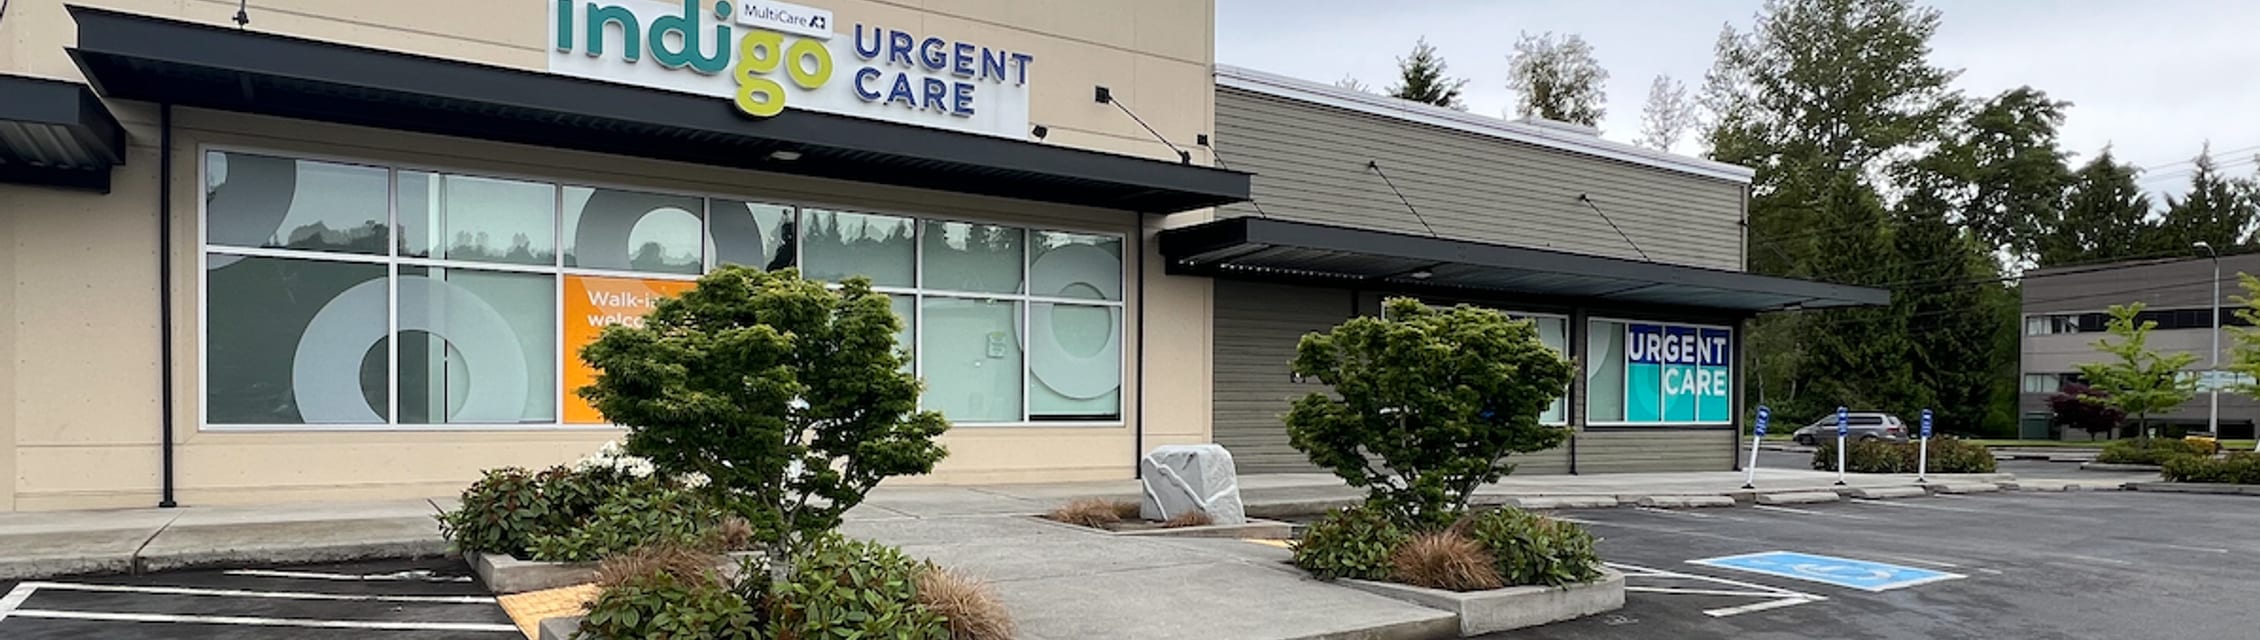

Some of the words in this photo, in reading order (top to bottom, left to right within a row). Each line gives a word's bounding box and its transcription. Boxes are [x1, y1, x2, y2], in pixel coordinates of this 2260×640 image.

[744, 3, 808, 27] MultiCare
[853, 23, 1033, 87] URGENT
[853, 66, 976, 117] CARE
[586, 312, 645, 329] welco
[1628, 332, 1727, 364] URGENT
[1663, 368, 1728, 396] CARE
